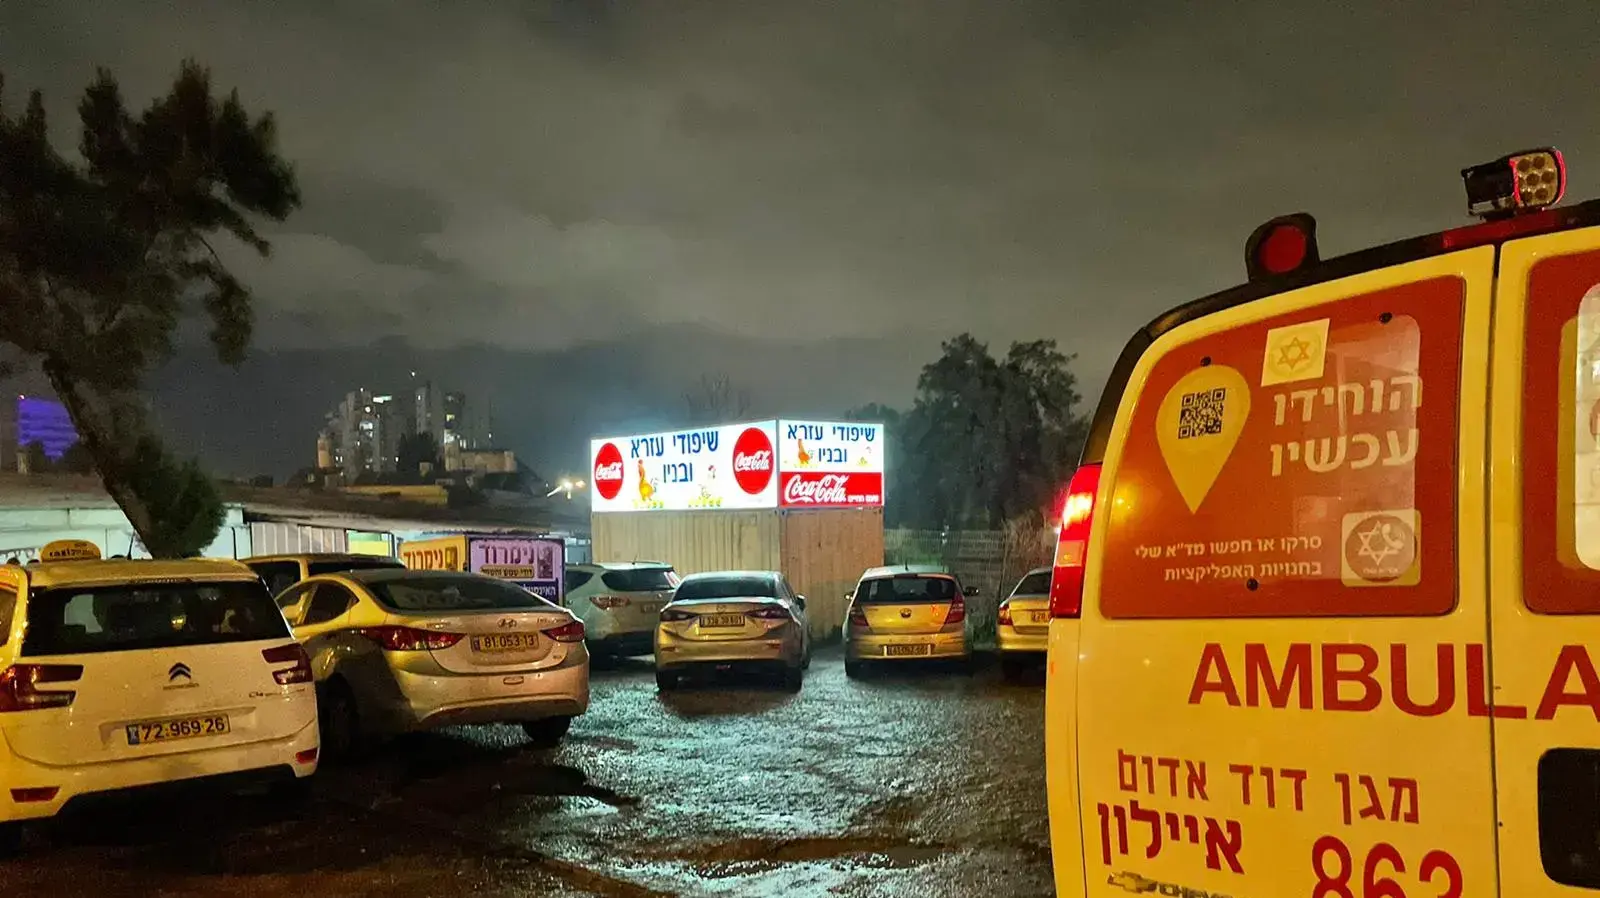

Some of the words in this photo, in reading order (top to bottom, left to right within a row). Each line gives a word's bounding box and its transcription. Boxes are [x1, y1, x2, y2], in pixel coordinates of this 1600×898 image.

[1274, 376, 1423, 426] הורידו
[672, 431, 719, 455] שיפודי
[787, 424, 824, 441] עזרא
[832, 426, 875, 442] שיפודי
[631, 436, 665, 458] עזרא
[818, 448, 847, 463] ובניו
[1270, 428, 1420, 477] עכשיו
[663, 462, 693, 483] ובניו
[479, 544, 534, 565] נימרוד
[1135, 545, 1162, 559] שלי
[1209, 540, 1252, 555] חפשו
[1257, 538, 1275, 552] או
[1280, 535, 1322, 554] סרקו
[403, 549, 443, 570] נימרוד
[1260, 561, 1322, 577] בחנויות
[1164, 563, 1255, 583] האפליקציות
[1187, 643, 1600, 723] AMBULA
[1117, 748, 1210, 801] אדום
[1229, 763, 1307, 812] דוד
[1334, 773, 1420, 825] מגן
[1097, 800, 1245, 875] איילון
